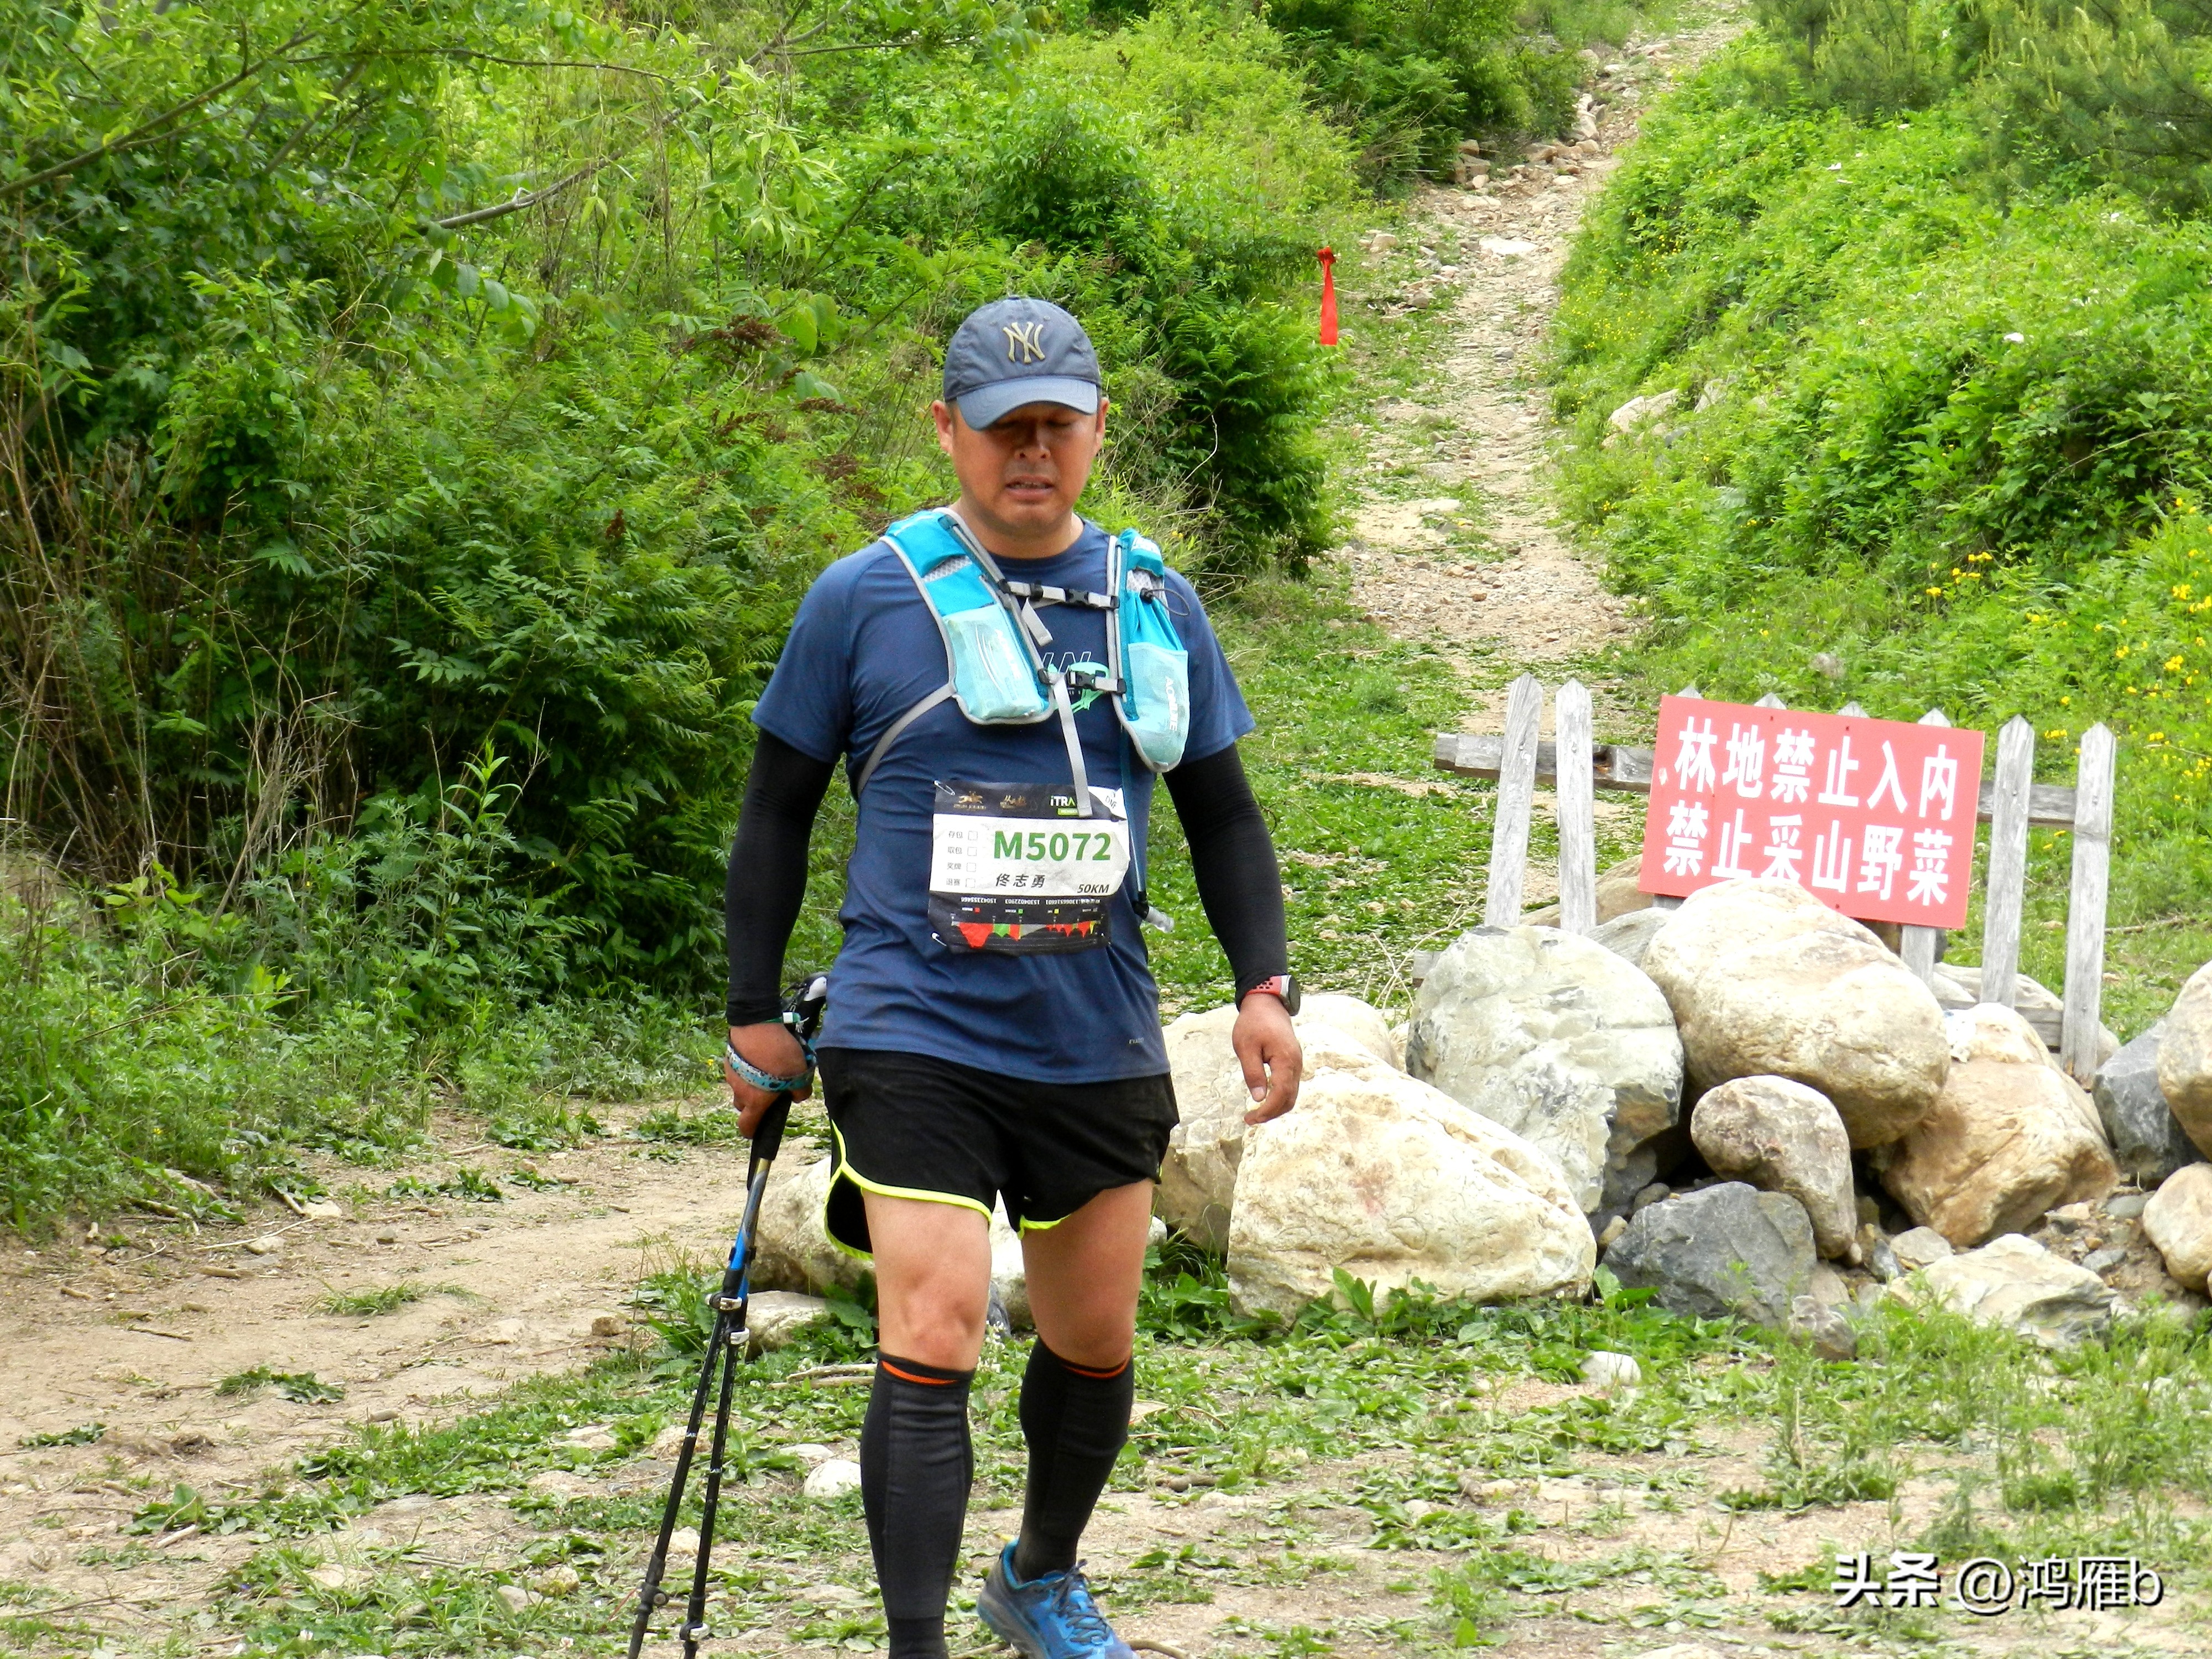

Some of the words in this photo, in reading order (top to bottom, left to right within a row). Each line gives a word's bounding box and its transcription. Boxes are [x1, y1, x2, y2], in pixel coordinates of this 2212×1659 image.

[1002, 322, 1046, 364] NY
[1674, 715, 1958, 822] 林地禁止入内
[993, 830, 1112, 862] M5072
[1662, 799, 1954, 907] 禁止采山野菜
[995, 873, 1046, 889] 佟志勇
[1076, 883, 1110, 895] 50KM
